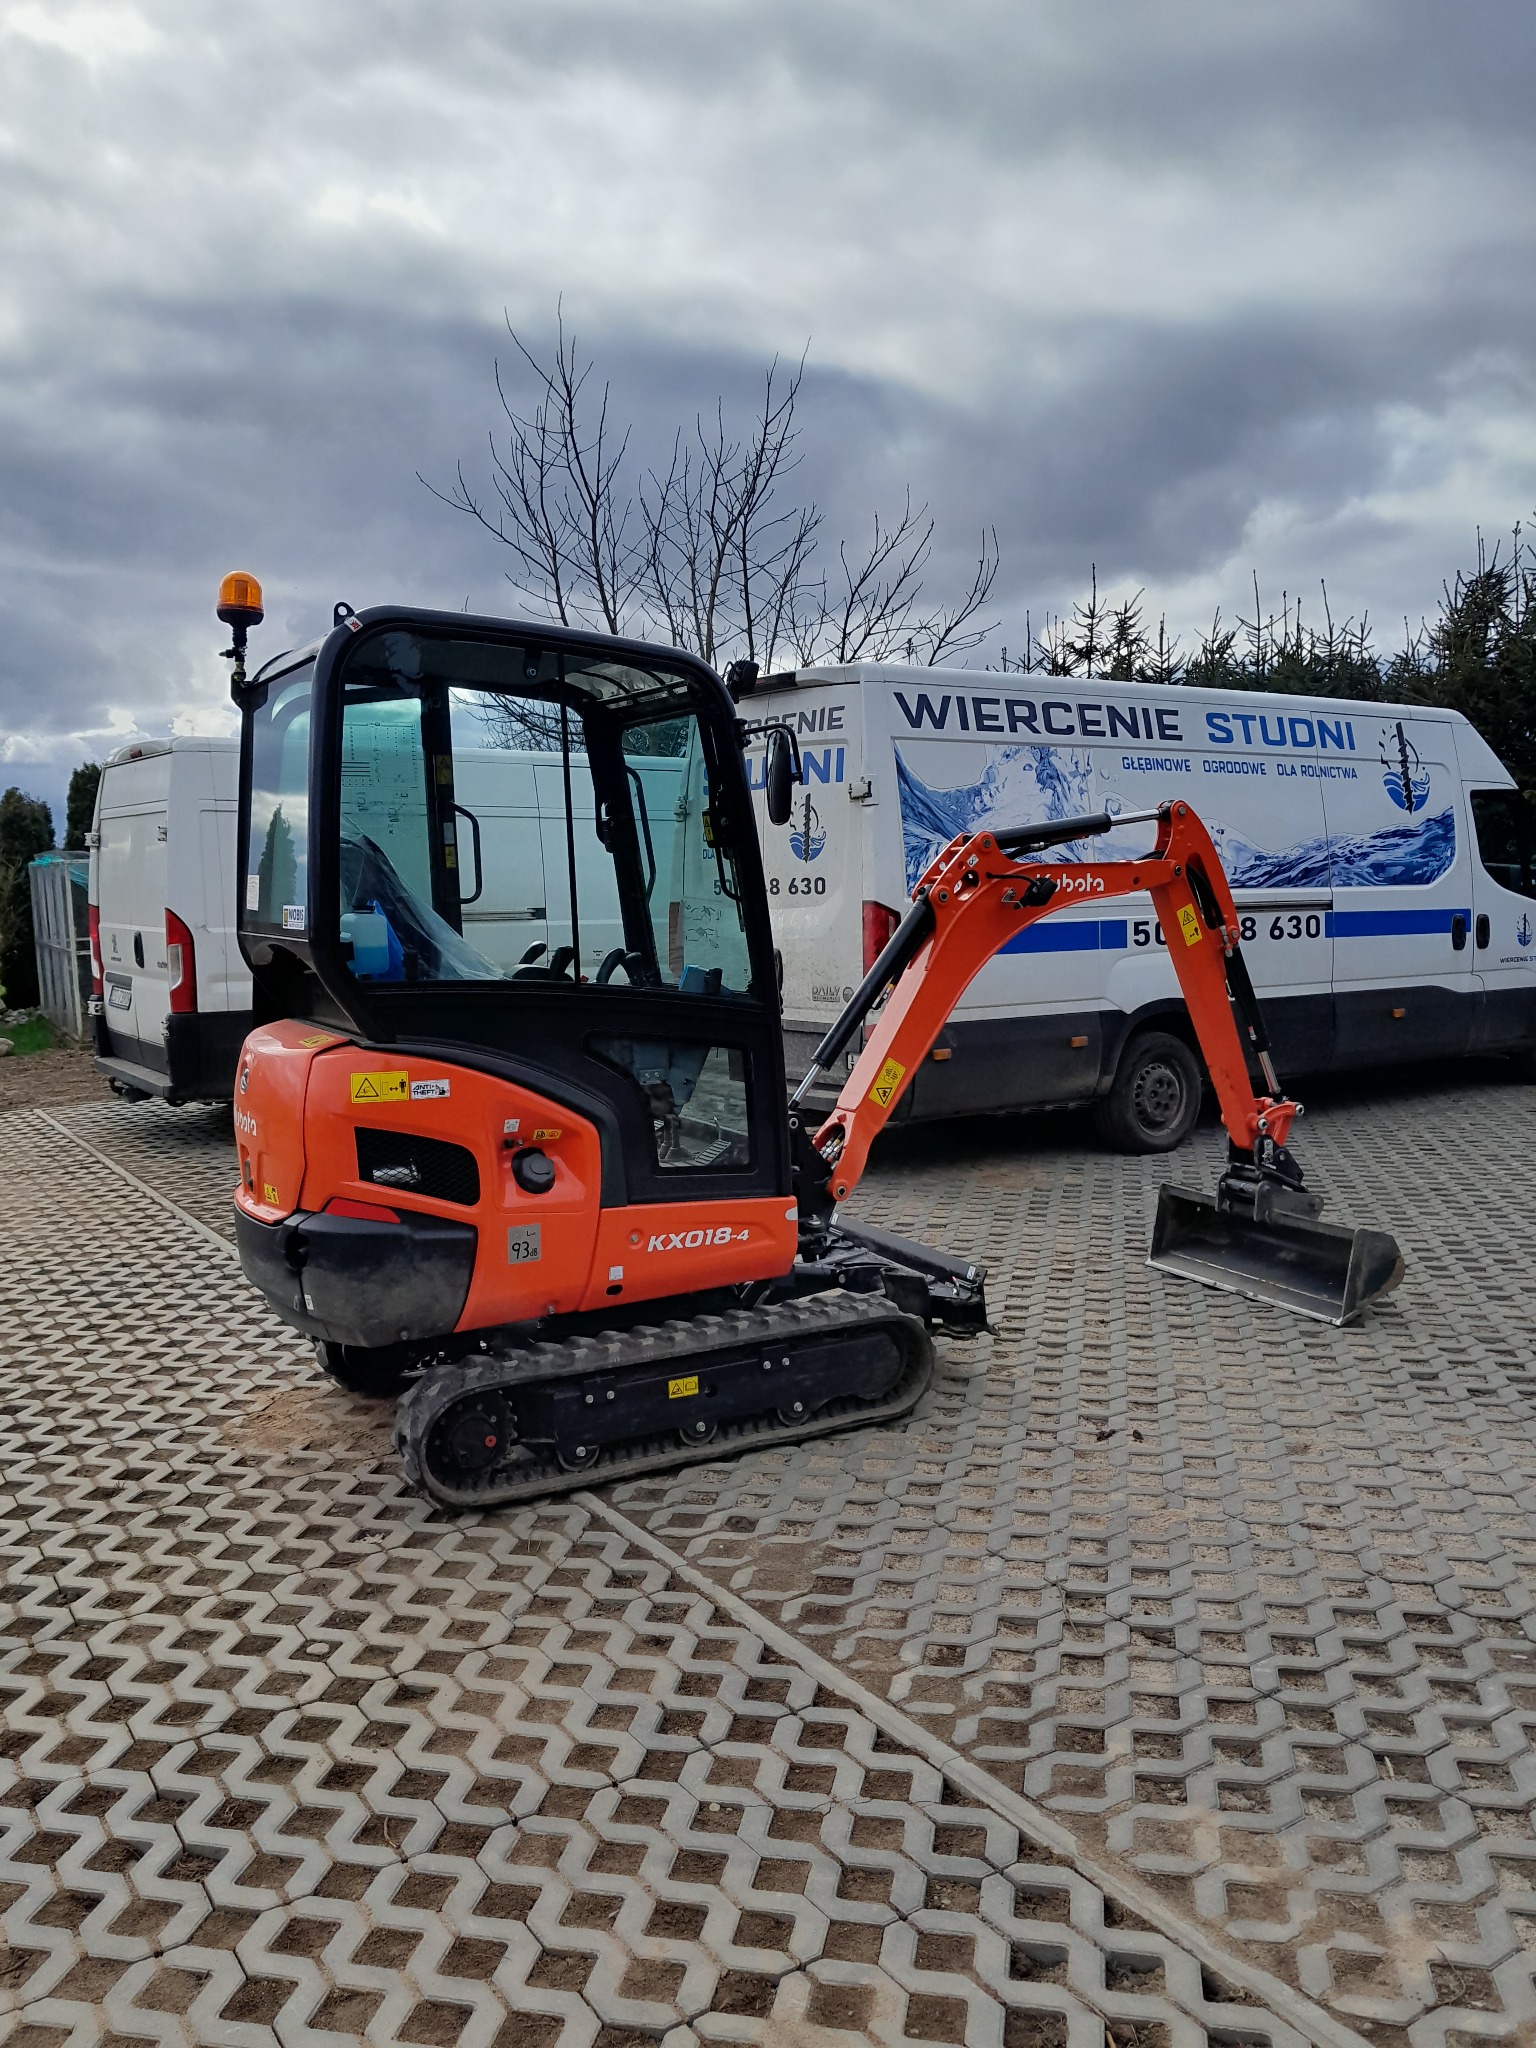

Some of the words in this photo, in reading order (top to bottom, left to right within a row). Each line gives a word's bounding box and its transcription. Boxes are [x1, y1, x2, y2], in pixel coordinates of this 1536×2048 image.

[747, 705, 845, 740] RCENIE
[893, 692, 1183, 741] WIERCENIE
[1206, 712, 1356, 750] STUDNI
[1122, 756, 1192, 774] GŁĘBINOWE
[1203, 760, 1267, 776] OGRODOWE
[1277, 763, 1298, 777] DLA
[1301, 765, 1358, 779] ROLNICTWA
[788, 877, 826, 895] 630
[1269, 914, 1321, 941] 630
[812, 985, 840, 996] DAILY
[647, 1226, 750, 1253] KX018-4
